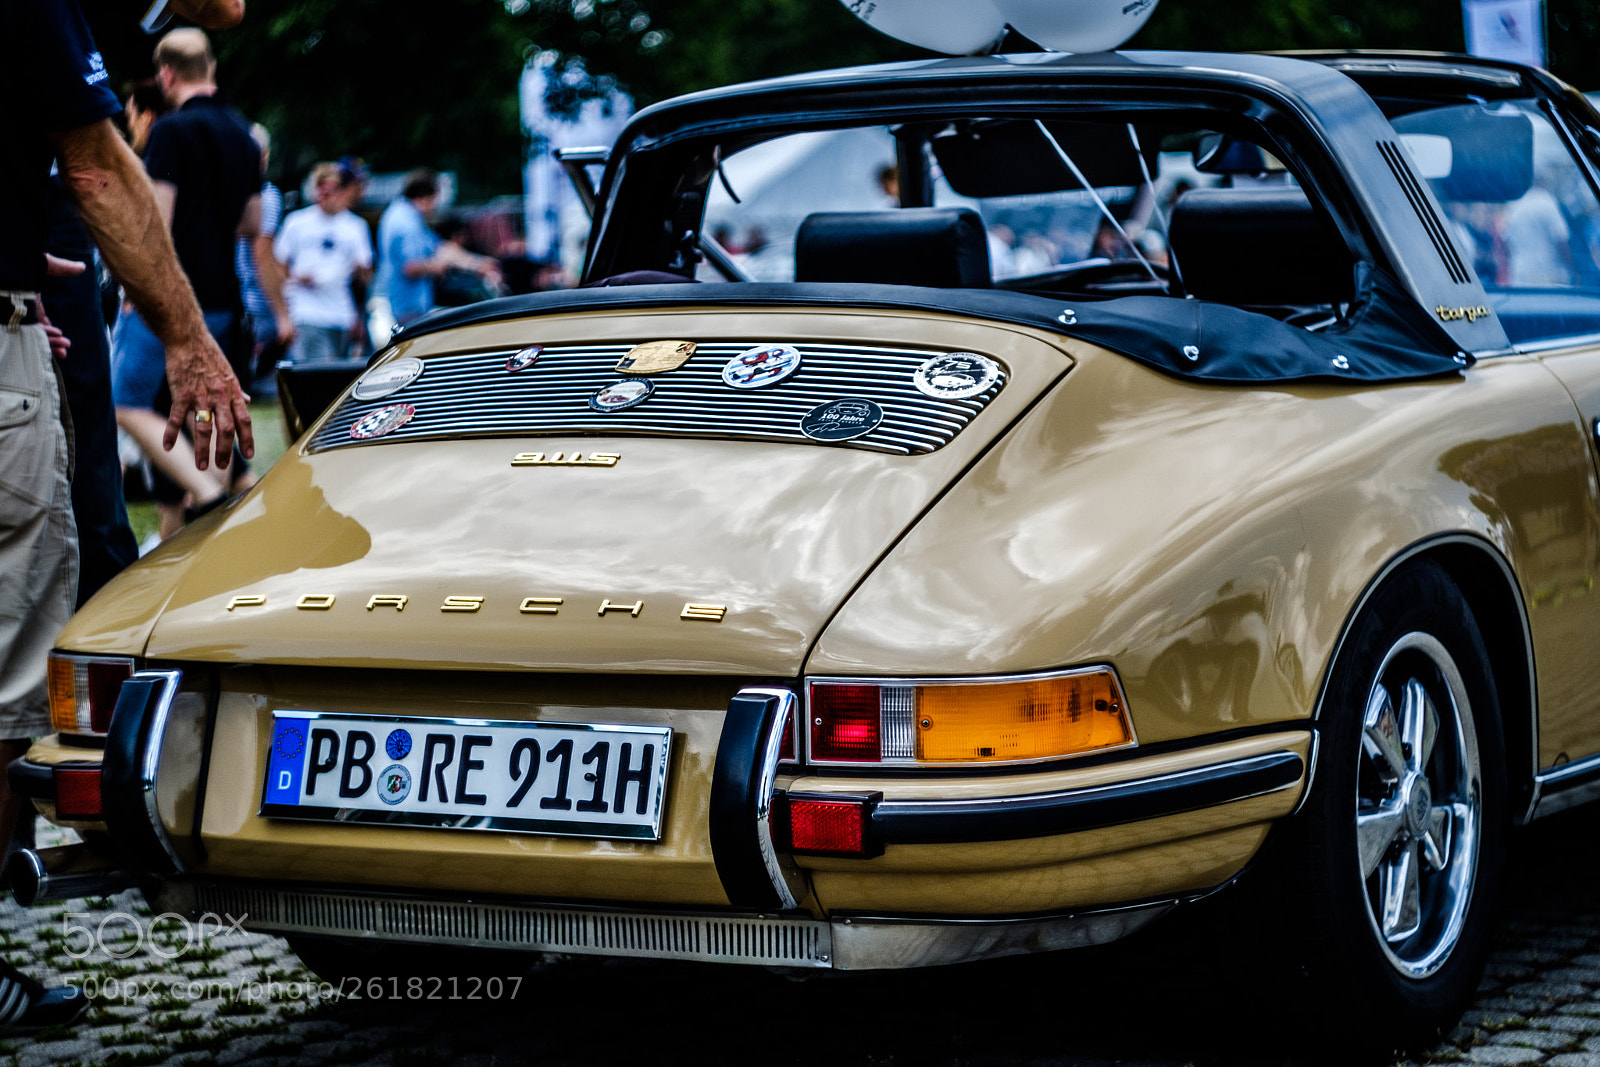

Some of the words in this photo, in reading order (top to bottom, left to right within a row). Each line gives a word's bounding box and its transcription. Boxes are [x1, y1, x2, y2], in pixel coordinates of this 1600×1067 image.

[1436, 304, 1491, 323] targa
[945, 359, 972, 369] 75
[840, 414, 865, 422] Jahre
[510, 451, 621, 467] 911S
[227, 593, 729, 622] PORSCHE
[278, 770, 291, 790] D
[305, 727, 376, 799] PB
[418, 733, 493, 806] RE
[506, 737, 654, 815] 911H
